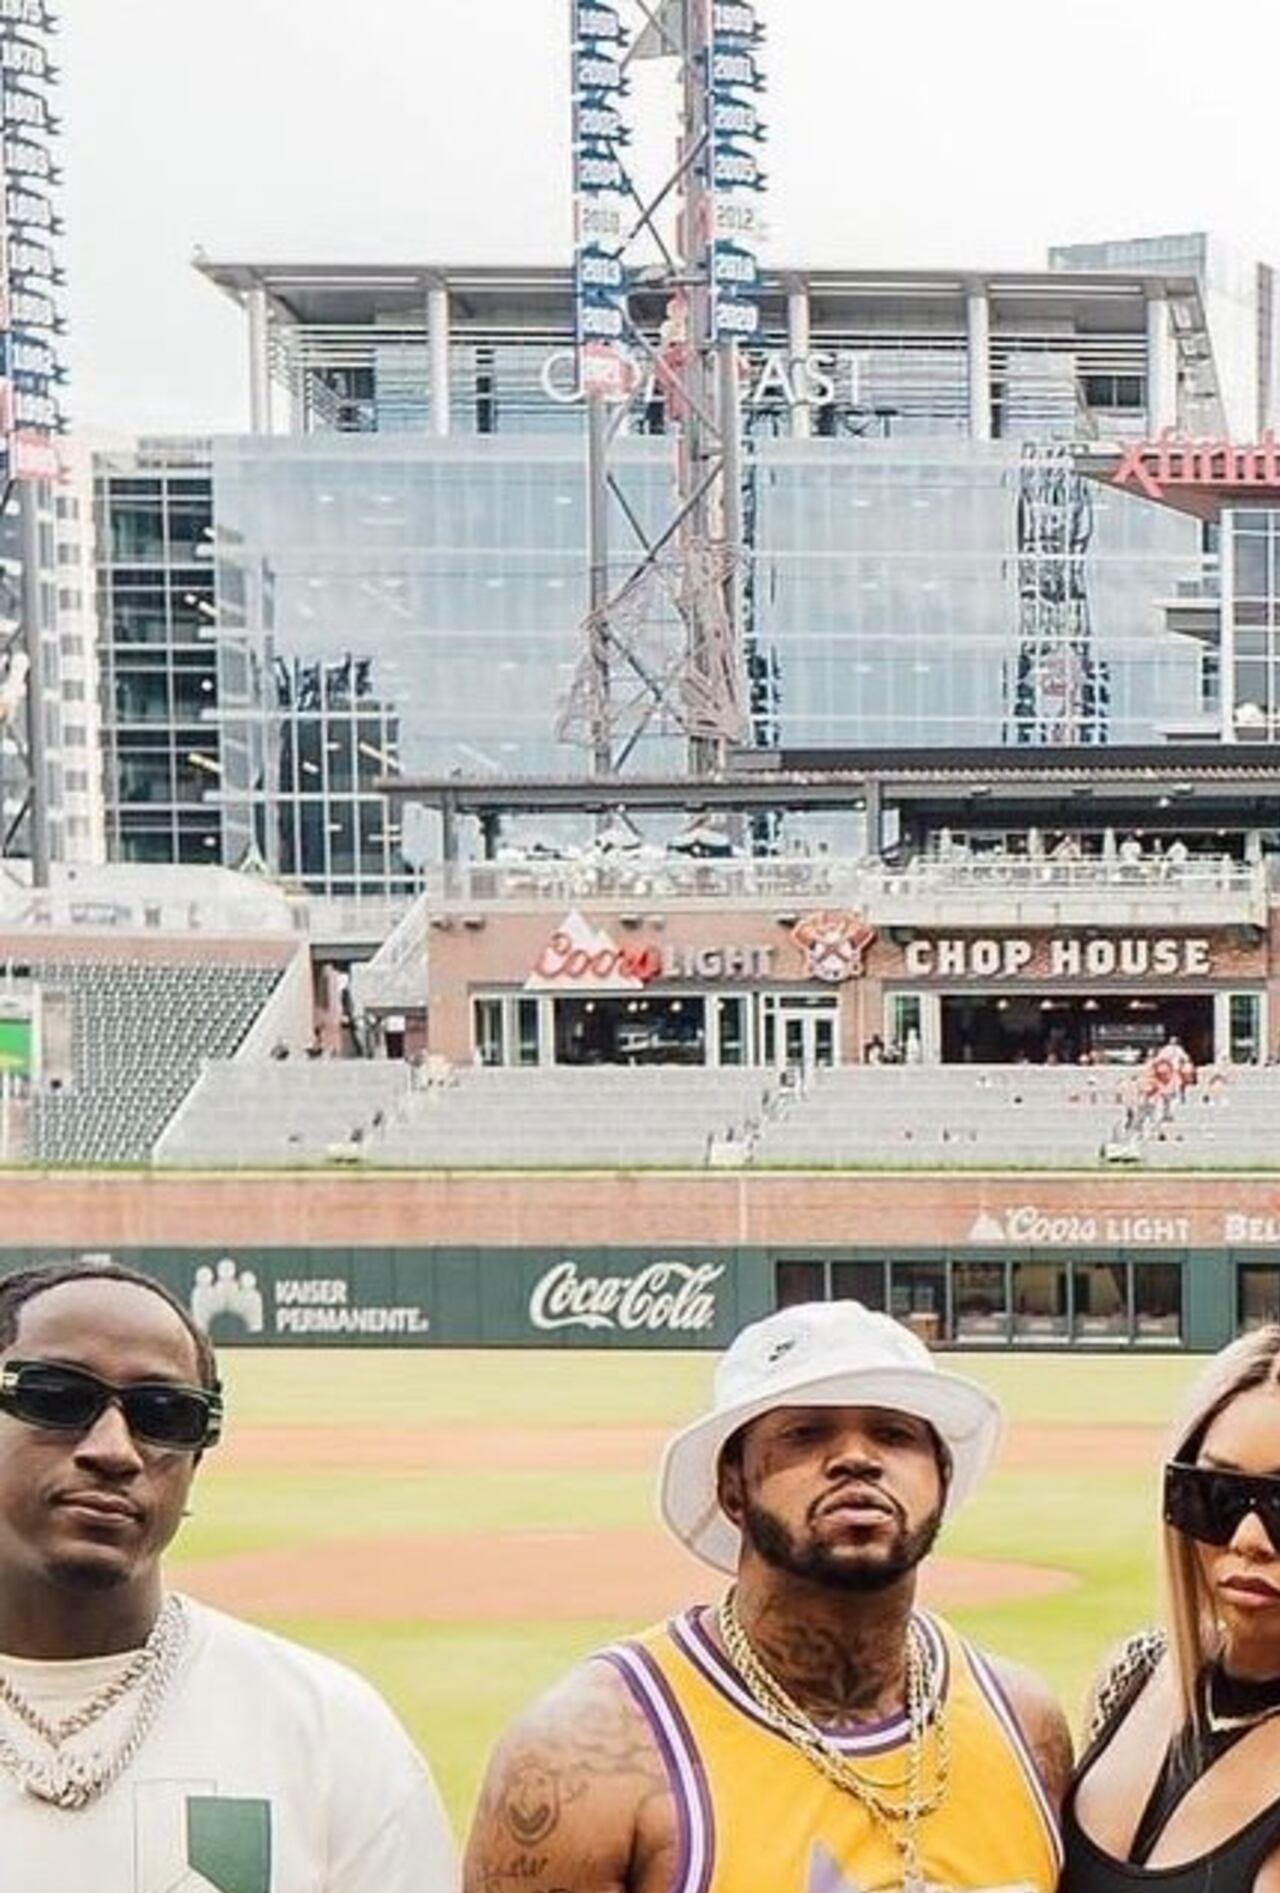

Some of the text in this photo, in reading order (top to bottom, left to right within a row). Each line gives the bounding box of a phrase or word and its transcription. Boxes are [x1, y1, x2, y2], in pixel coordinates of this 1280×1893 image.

[665, 945, 775, 979] LIGHT
[904, 938, 1211, 976] CHOP HOUSE
[1105, 1217, 1190, 1242] LIGHT
[275, 1280, 348, 1304] KAISER
[276, 1307, 423, 1333] PERMANENTE
